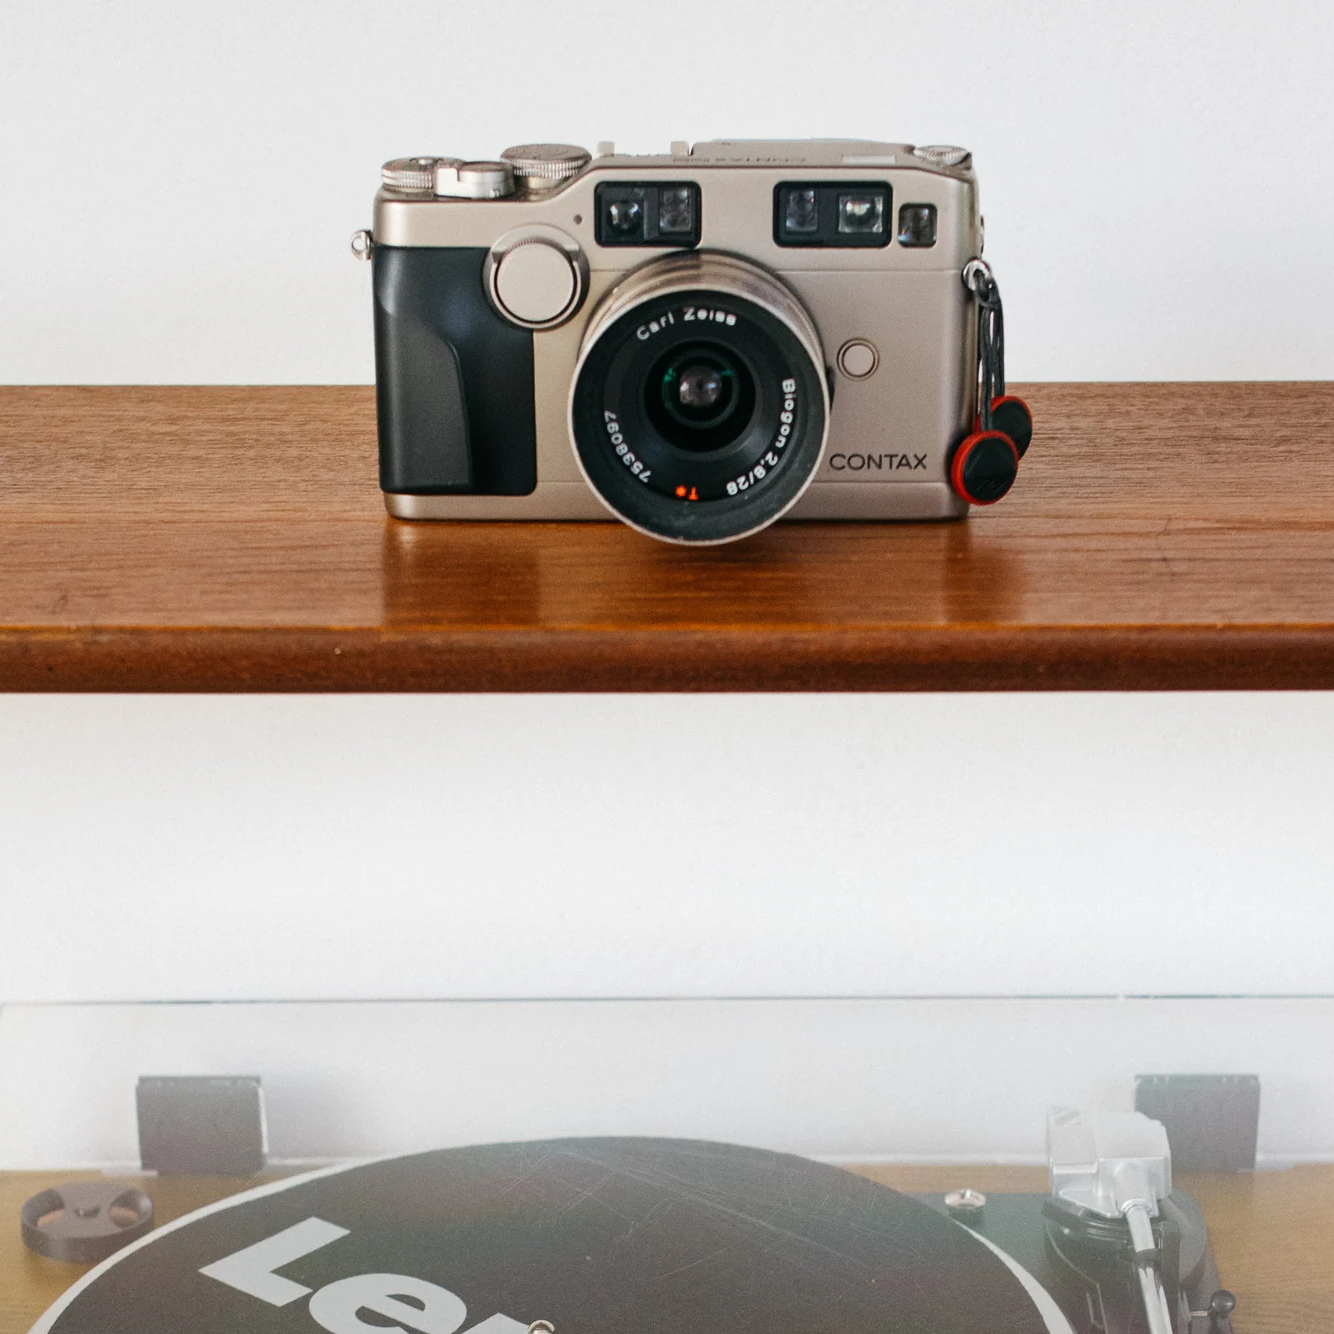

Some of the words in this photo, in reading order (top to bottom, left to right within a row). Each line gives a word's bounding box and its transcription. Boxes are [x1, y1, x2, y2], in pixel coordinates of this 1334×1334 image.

[636, 310, 675, 341] Carl
[683, 306, 737, 326] Zeiss
[774, 378, 796, 448] Biogon
[604, 410, 652, 483] 7538097
[829, 453, 928, 471] CONTAX
